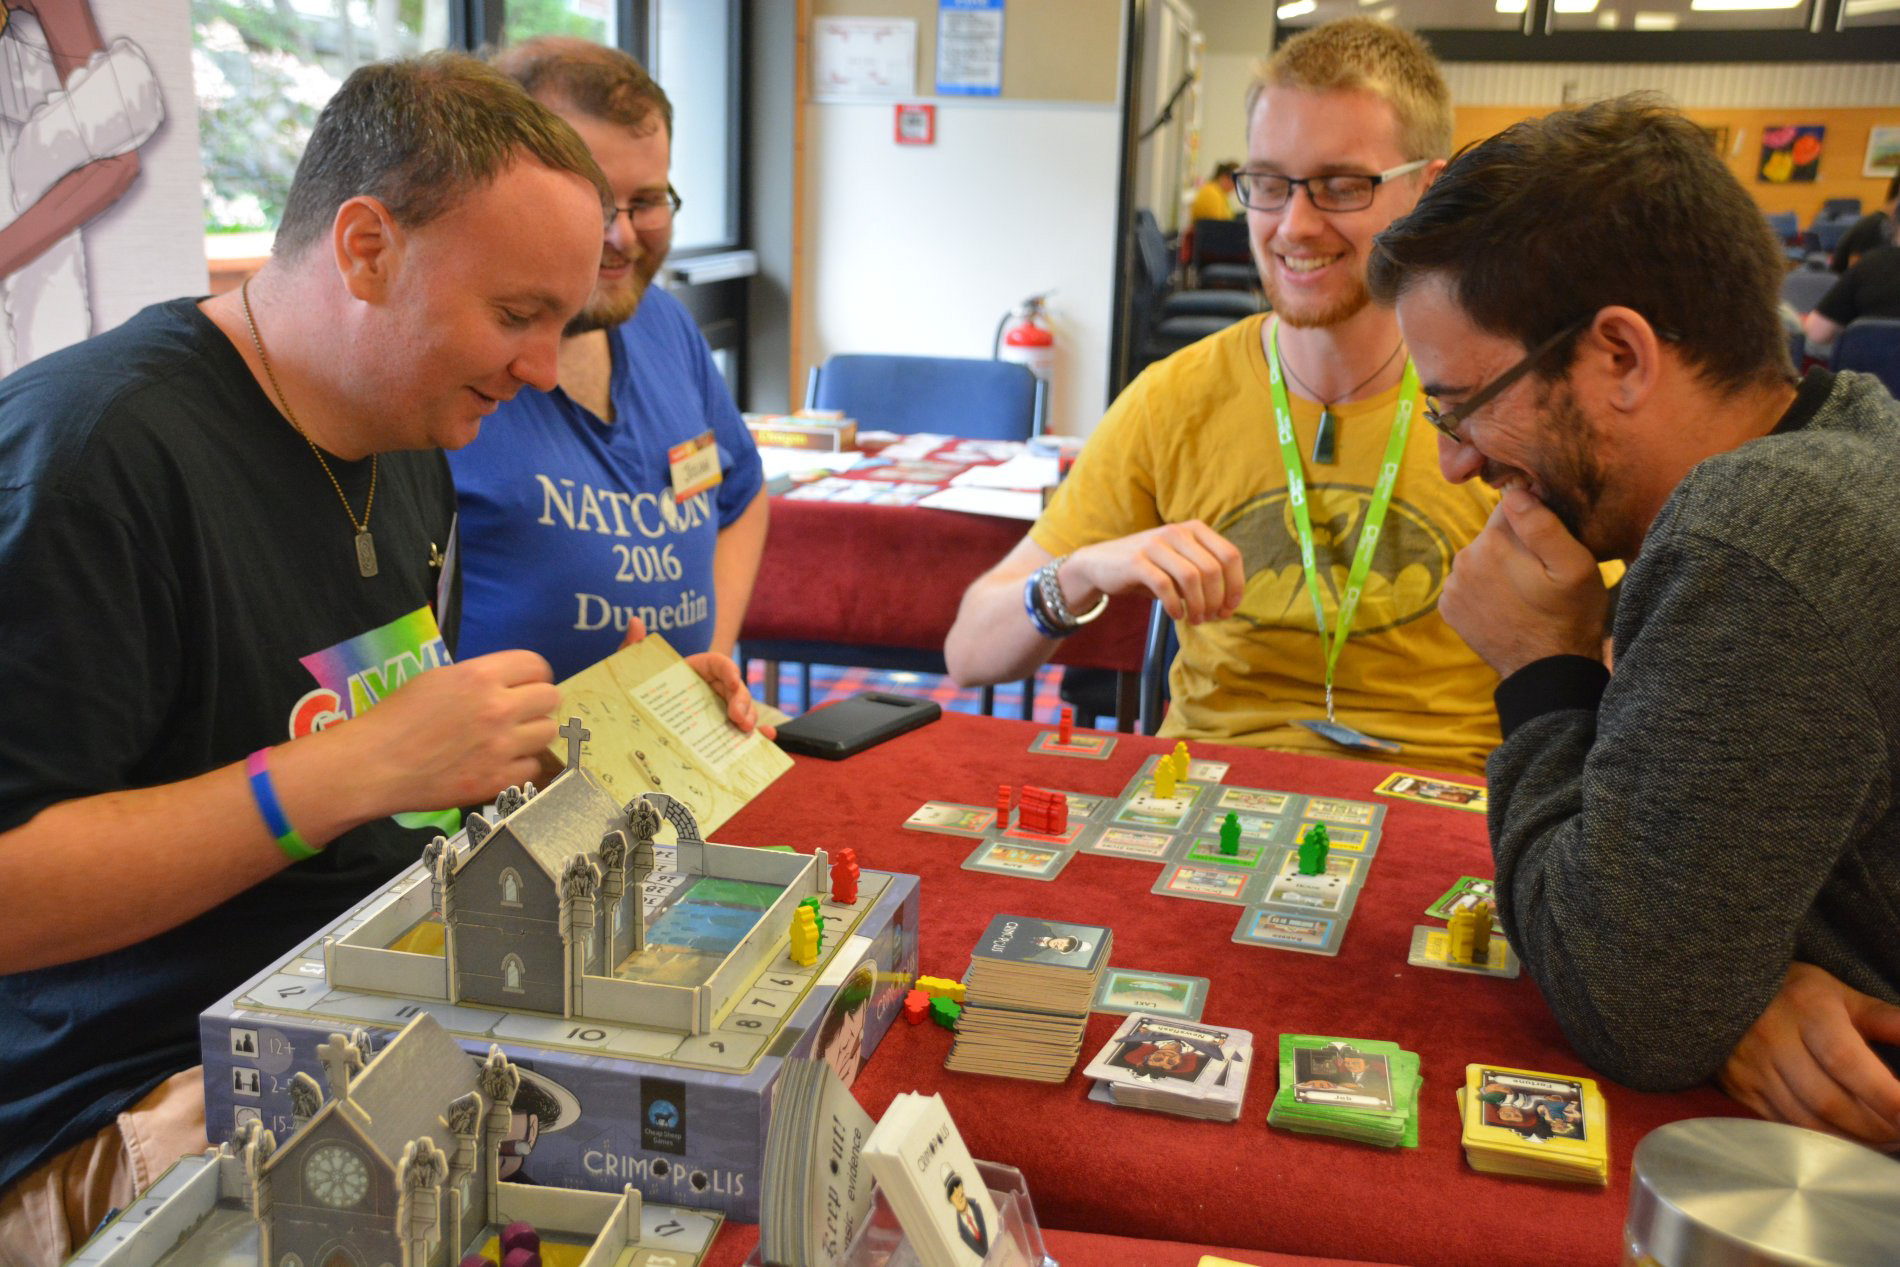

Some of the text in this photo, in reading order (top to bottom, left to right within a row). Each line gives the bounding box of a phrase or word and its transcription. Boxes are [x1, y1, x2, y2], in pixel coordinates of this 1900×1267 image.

[535, 473, 711, 538] NATCON
[612, 543, 683, 583] 2016
[573, 589, 707, 632] Dunedin
[1133, 1001, 1157, 1009] LAKE
[566, 1027, 607, 1042] 10
[736, 1019, 763, 1029] 8
[1157, 1025, 1206, 1040] Newsflash
[269, 1037, 296, 1055] 12+
[583, 1149, 744, 1197] CRIMOPOLIS
[847, 1127, 862, 1202] evidence
